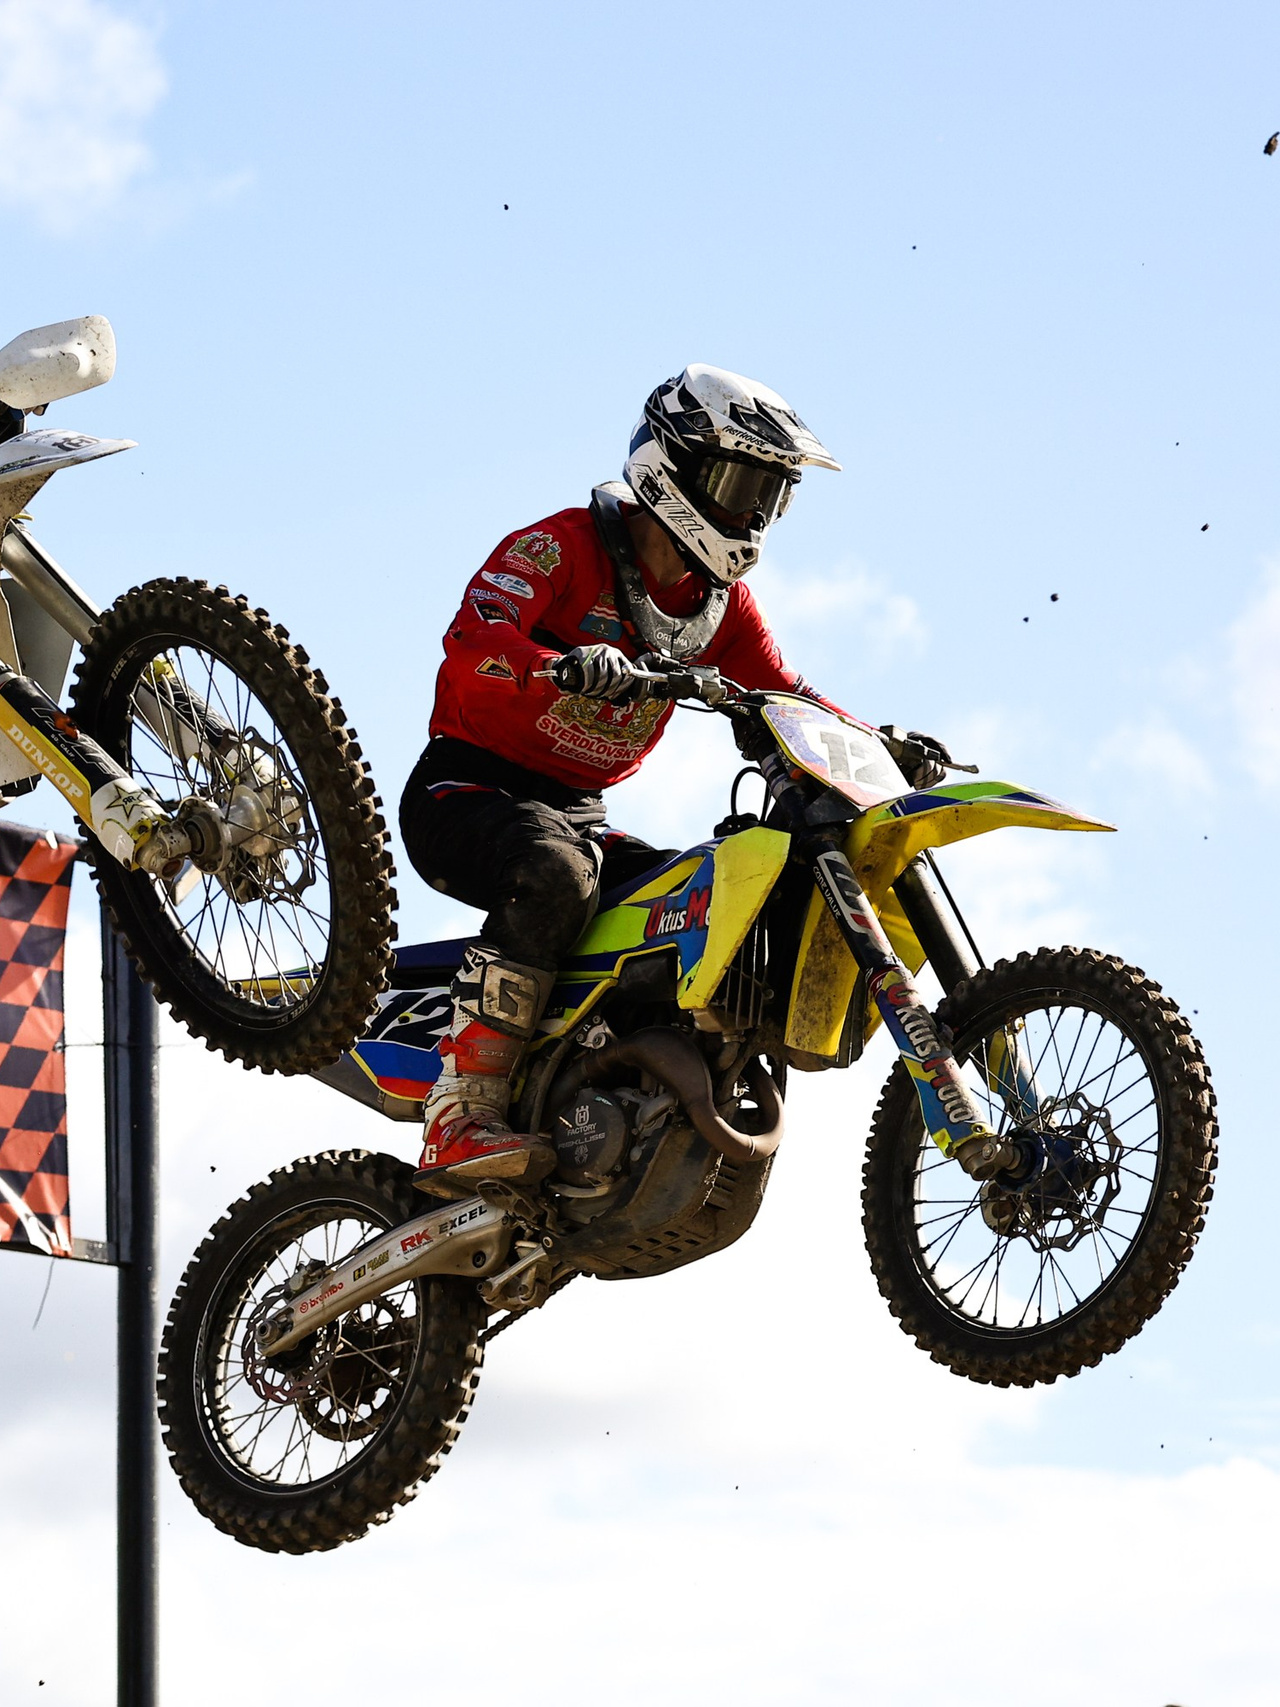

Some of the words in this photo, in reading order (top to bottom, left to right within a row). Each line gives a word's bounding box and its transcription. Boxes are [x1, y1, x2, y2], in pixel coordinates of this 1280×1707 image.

[722, 424, 769, 448] FASTHOUSE
[536, 715, 644, 760] SVERDLOVSKY
[6, 724, 84, 800] DUNLOP
[553, 742, 615, 769] REGION
[819, 731, 897, 792] 12
[824, 888, 842, 920] VALVE
[360, 991, 455, 1051] 12
[567, 1122, 597, 1137] FACTORY
[425, 1143, 438, 1164] G
[438, 1204, 488, 1235] EXCEL
[400, 1228, 434, 1253] RK
[309, 1281, 345, 1309] brembo
